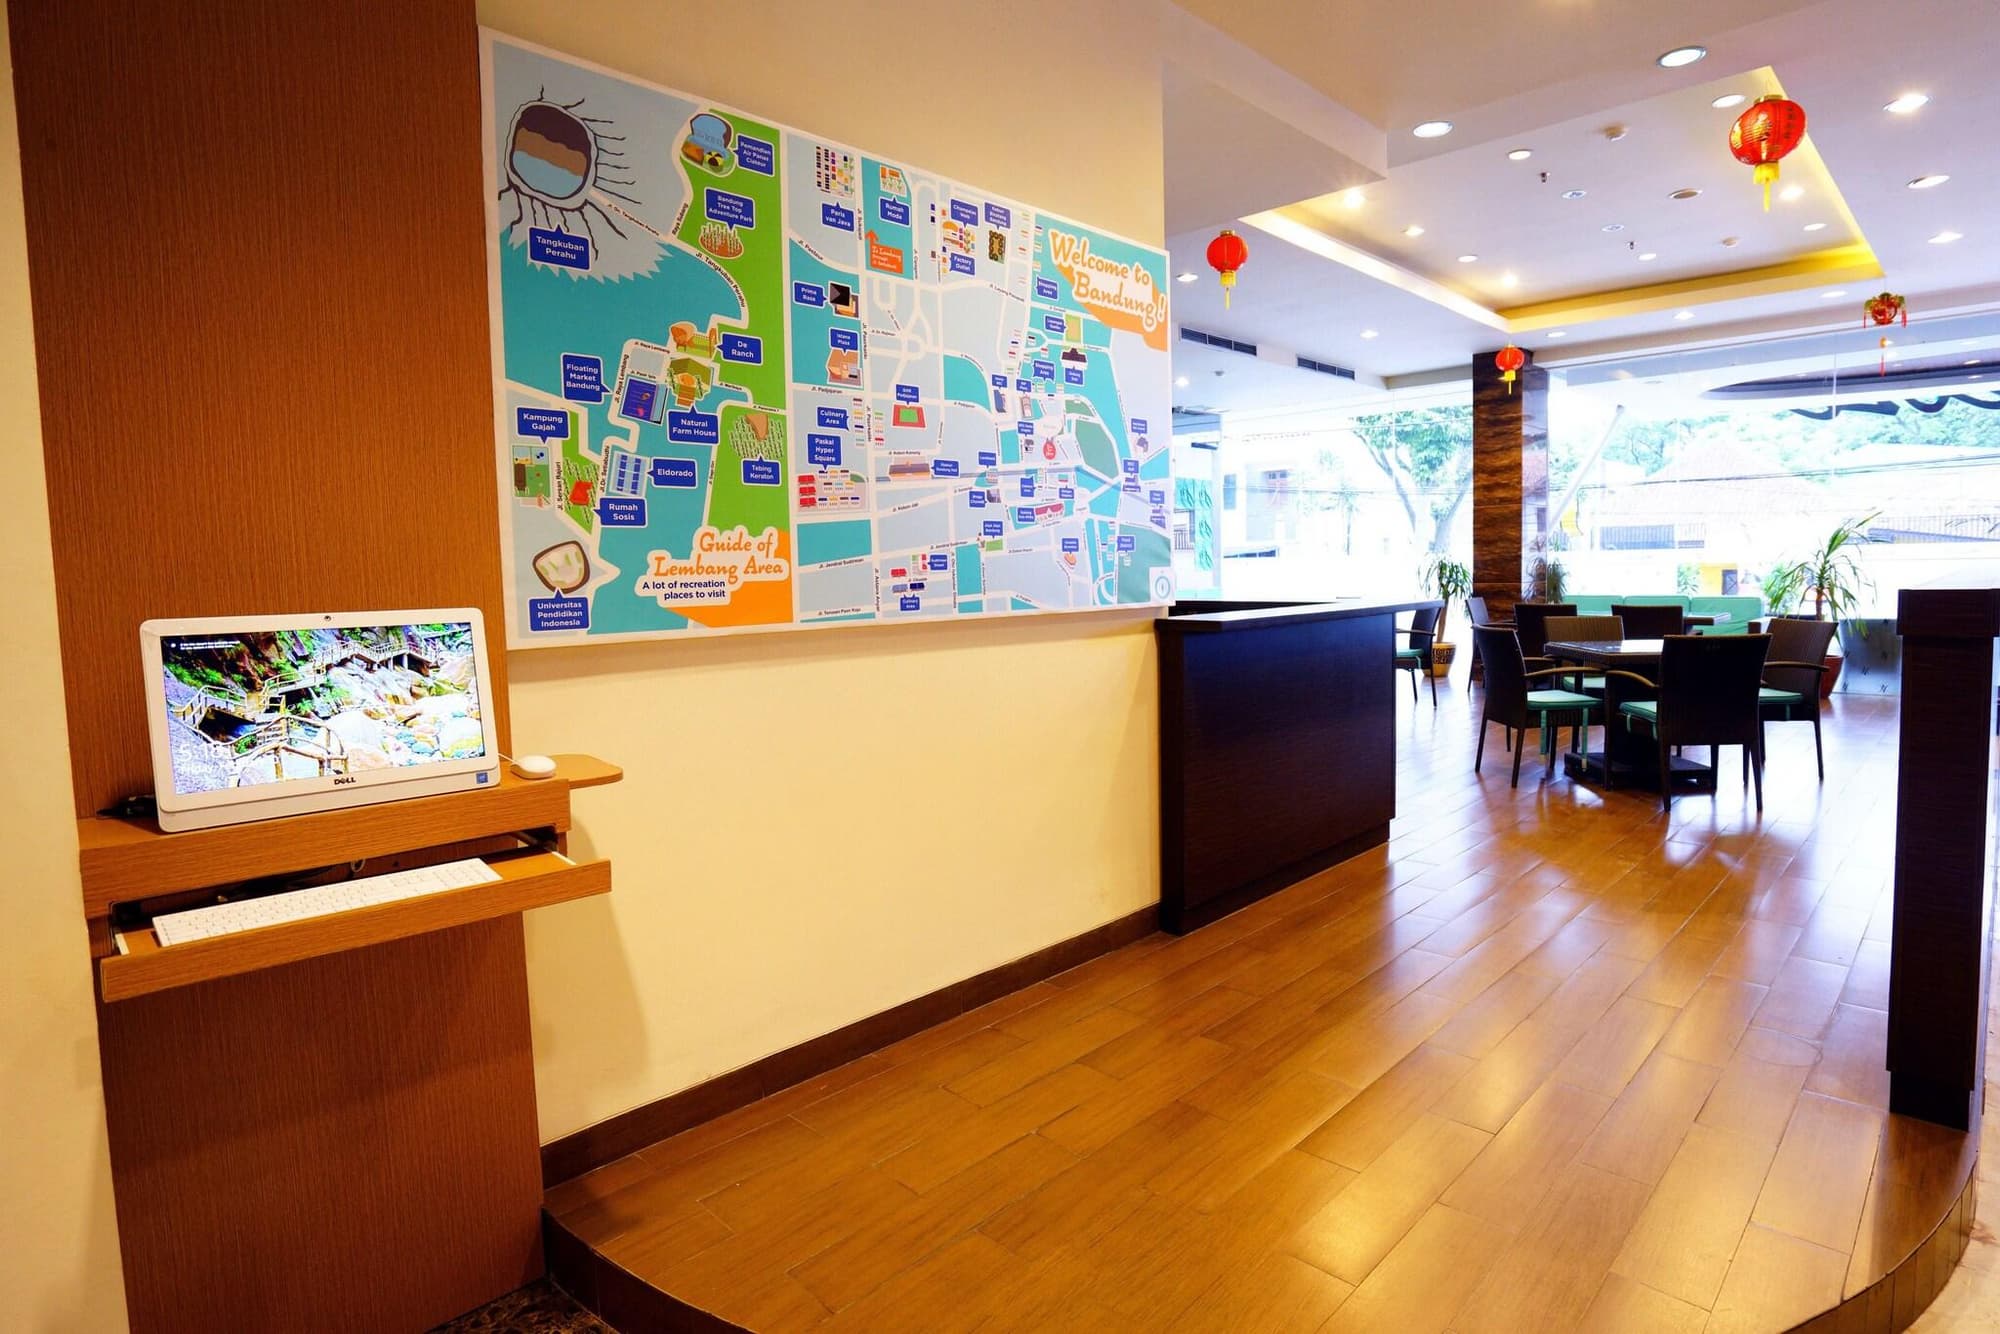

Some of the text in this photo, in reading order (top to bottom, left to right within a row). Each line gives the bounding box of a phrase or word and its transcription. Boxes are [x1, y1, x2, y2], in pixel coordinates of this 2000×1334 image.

[708, 208, 739, 220] Adventure
[536, 236, 585, 252] Tangkuban
[545, 247, 576, 260] Perahu
[1051, 231, 1150, 286] Welcome to
[1075, 271, 1166, 328] Bandung!
[732, 348, 754, 358] Ranch
[566, 363, 598, 374] Floating
[569, 372, 598, 382] Market
[566, 381, 600, 392] Bandung
[522, 413, 563, 424] Kampung
[820, 410, 844, 419] Culinary
[532, 422, 556, 432] Gajah
[680, 418, 708, 428] Natural
[672, 426, 717, 437] Farm House
[815, 438, 834, 446] Paskal
[815, 446, 834, 454] Hyper
[814, 454, 836, 462] Square
[656, 468, 694, 478] Eldorado
[752, 464, 772, 473] Tebing
[750, 472, 774, 480] Keraton
[608, 503, 638, 512] Rumah
[612, 512, 635, 522] Sosis
[700, 532, 774, 556] Guide of
[654, 556, 784, 584] Lembang Area
[642, 580, 726, 590] A lot of recreation
[664, 590, 726, 602] places to visit
[537, 600, 582, 610] Universitas
[538, 610, 583, 620] Pendidikan
[541, 618, 580, 628] Indonesia
[334, 776, 356, 785] DELL
